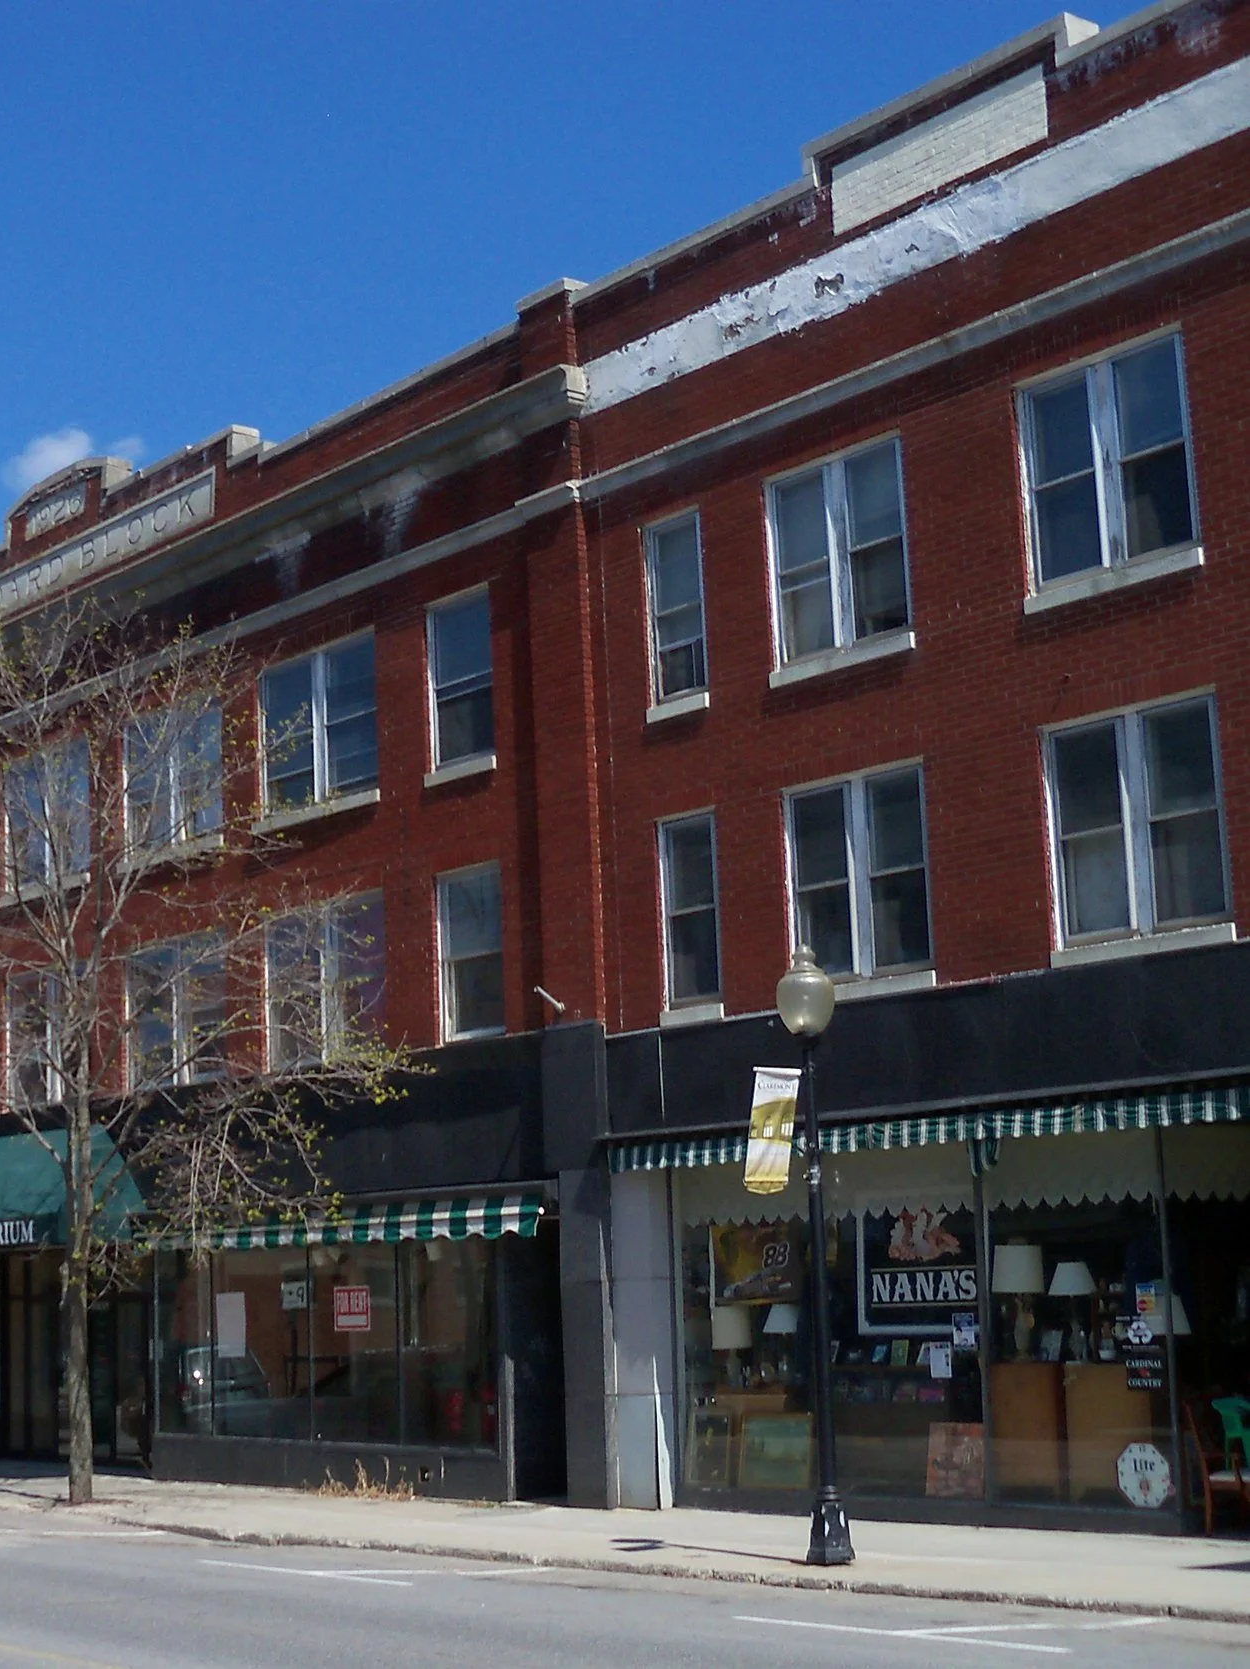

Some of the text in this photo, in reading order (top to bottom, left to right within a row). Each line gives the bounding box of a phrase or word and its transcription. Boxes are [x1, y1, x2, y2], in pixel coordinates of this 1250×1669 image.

[80, 488, 196, 570] BLOCK
[762, 1242, 790, 1269] 88
[871, 1269, 977, 1303] NANA'S
[337, 1291, 366, 1313] FOR RENT
[1125, 1359, 1162, 1369] CARDINAL
[1127, 1378, 1162, 1388] COUNTRY
[1132, 1458, 1156, 1473] Lite
